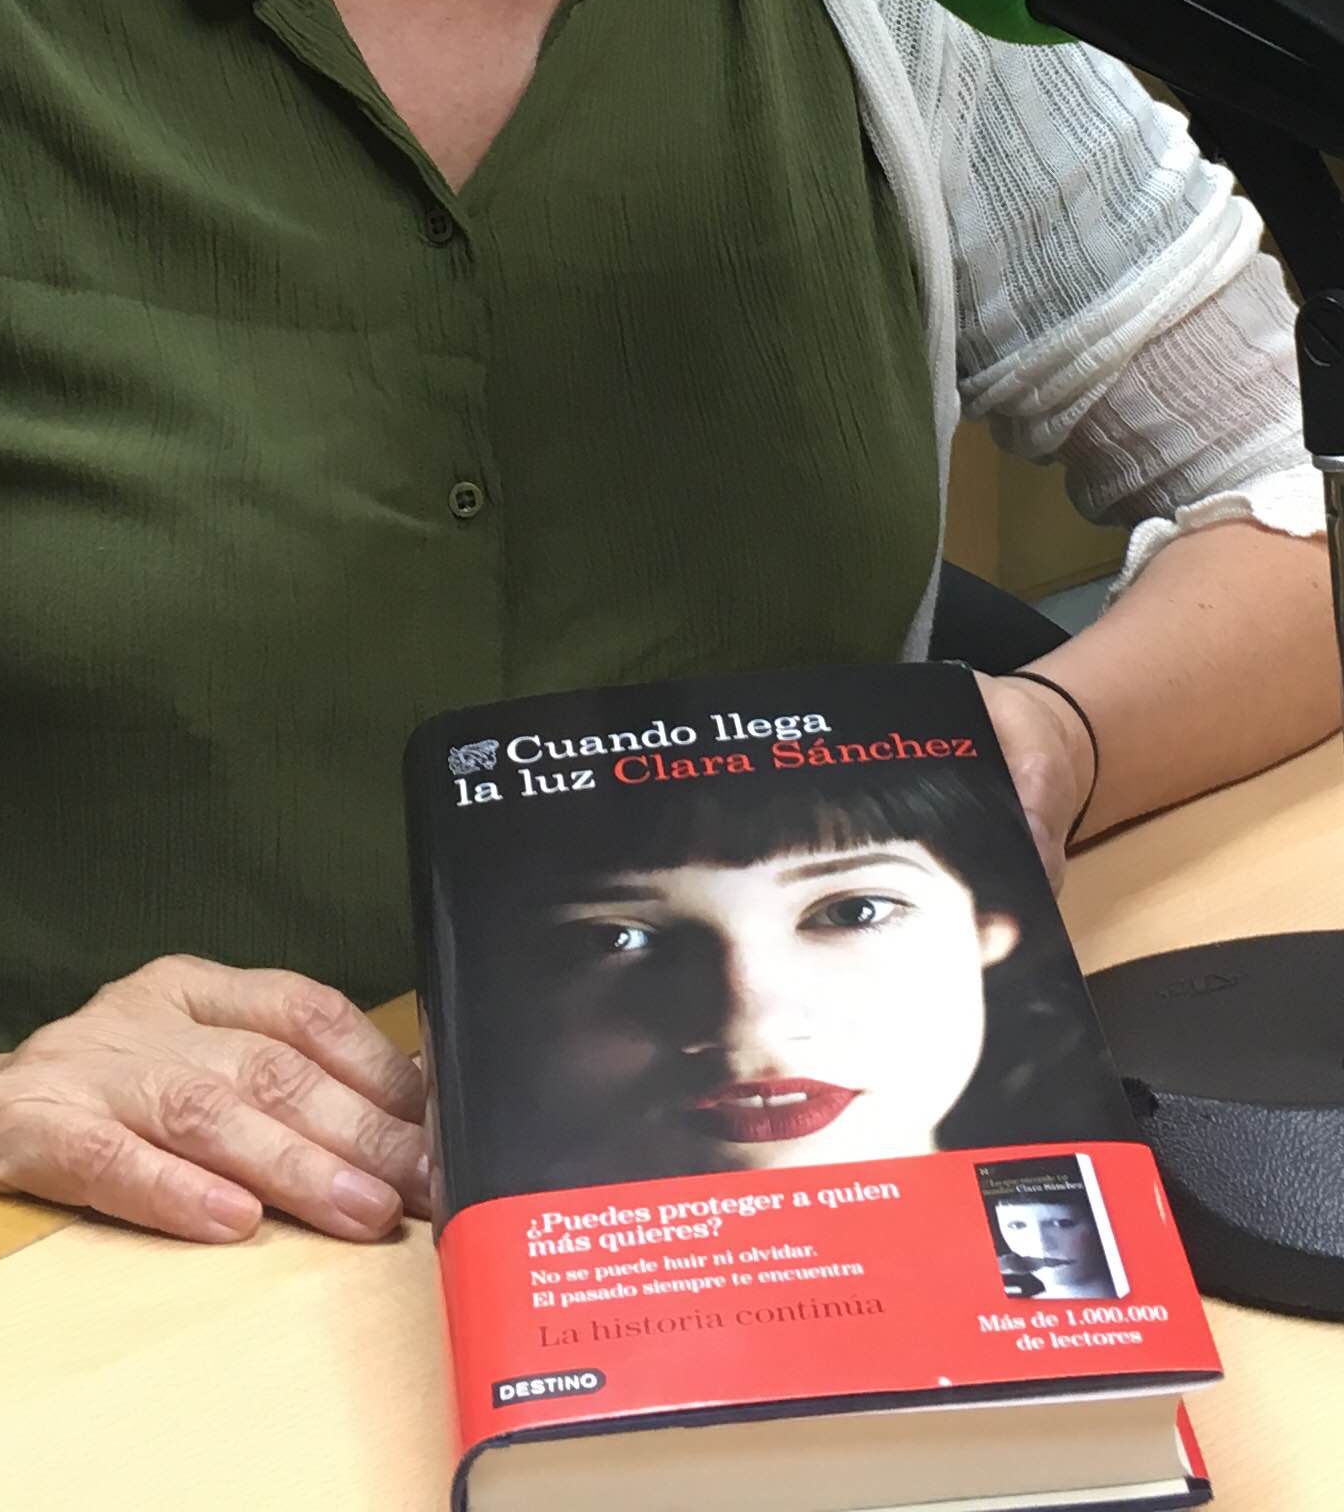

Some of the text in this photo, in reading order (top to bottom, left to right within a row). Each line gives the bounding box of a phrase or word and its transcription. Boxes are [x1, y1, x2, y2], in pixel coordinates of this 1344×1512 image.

[506, 713, 832, 764] Cuando llega
[454, 733, 978, 806] la luz Clara Sánchez
[526, 1181, 901, 1239] ¿Puedes proteger a quien
[528, 1217, 723, 1257] más quieres?
[530, 1243, 818, 1286] No se puede huir ni olvidar.
[532, 1262, 865, 1309] El pasado siempre te encuentra
[538, 1294, 886, 1348] La historia continúa
[977, 1304, 1169, 1333] Más de 1.000.000
[1016, 1330, 1144, 1352] de lectores
[498, 1372, 599, 1402] DESTINO
